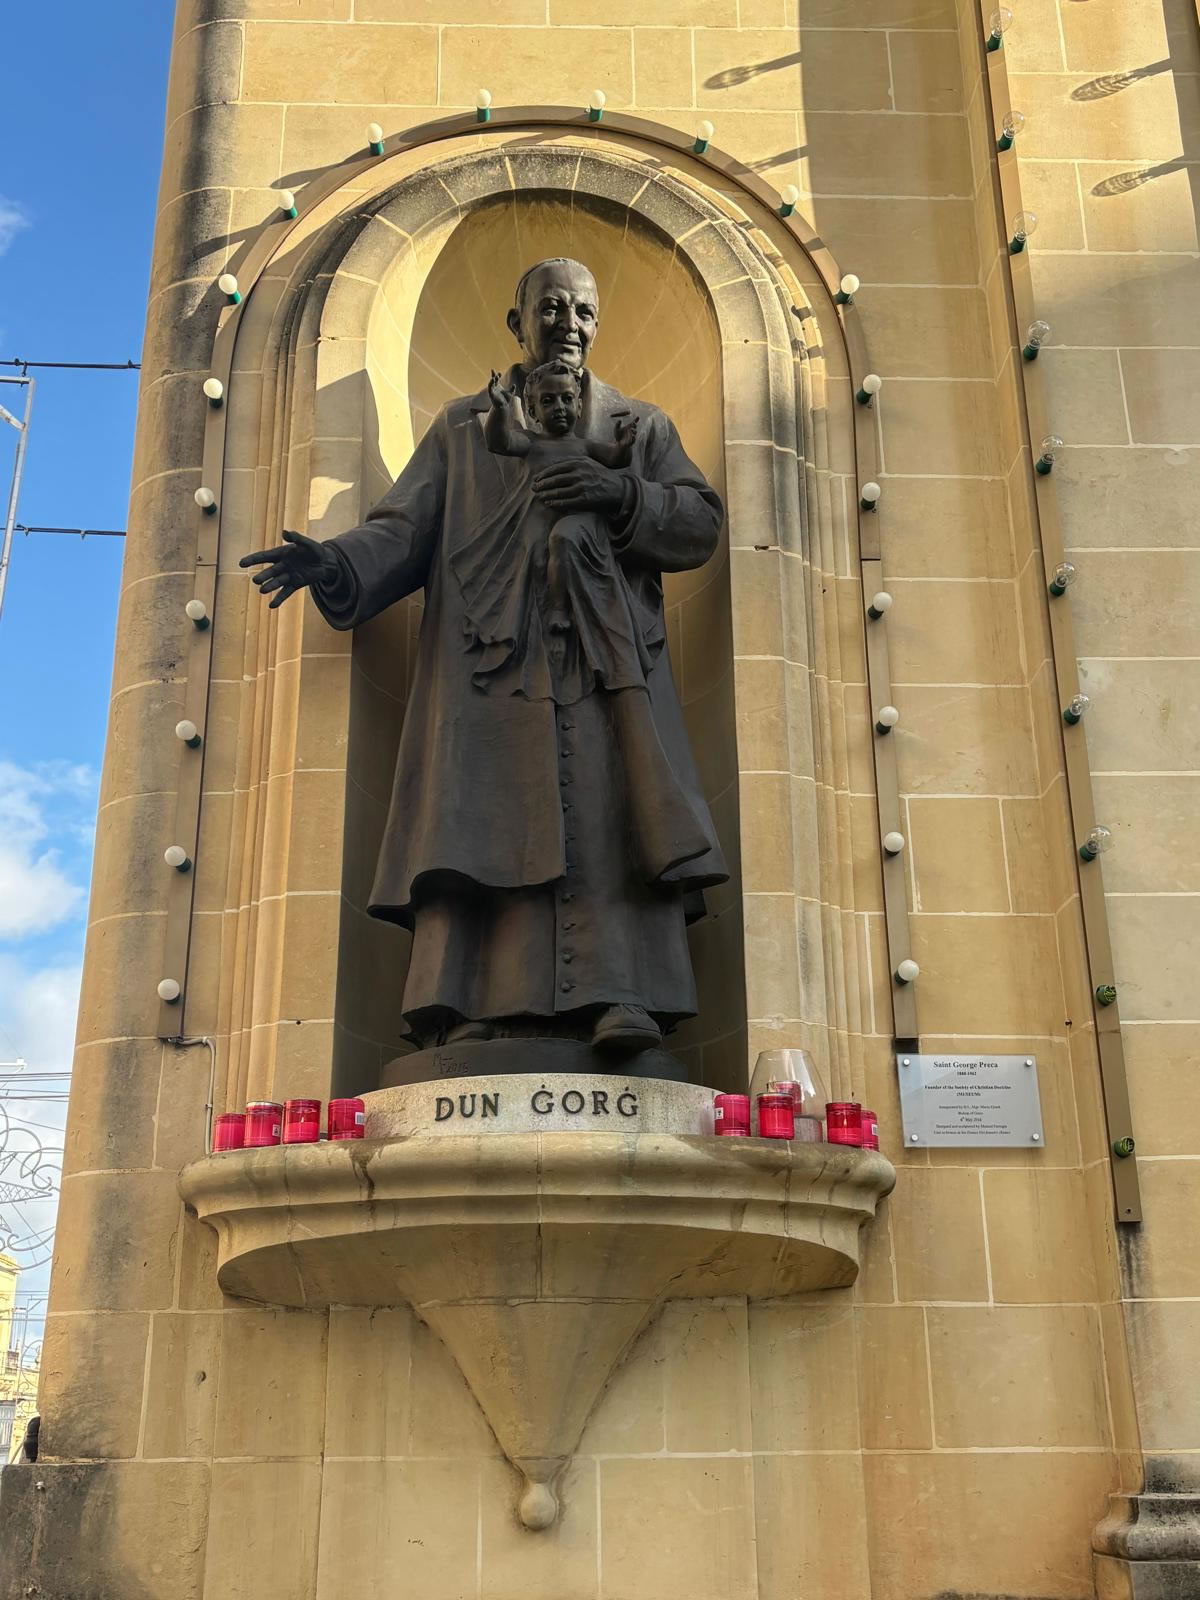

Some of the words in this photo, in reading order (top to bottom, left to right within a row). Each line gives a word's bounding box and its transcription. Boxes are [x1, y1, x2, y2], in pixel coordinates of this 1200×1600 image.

[952, 1061, 977, 1069] George
[434, 1093, 500, 1121] DUN
[531, 1084, 638, 1117] ĠORĠ
